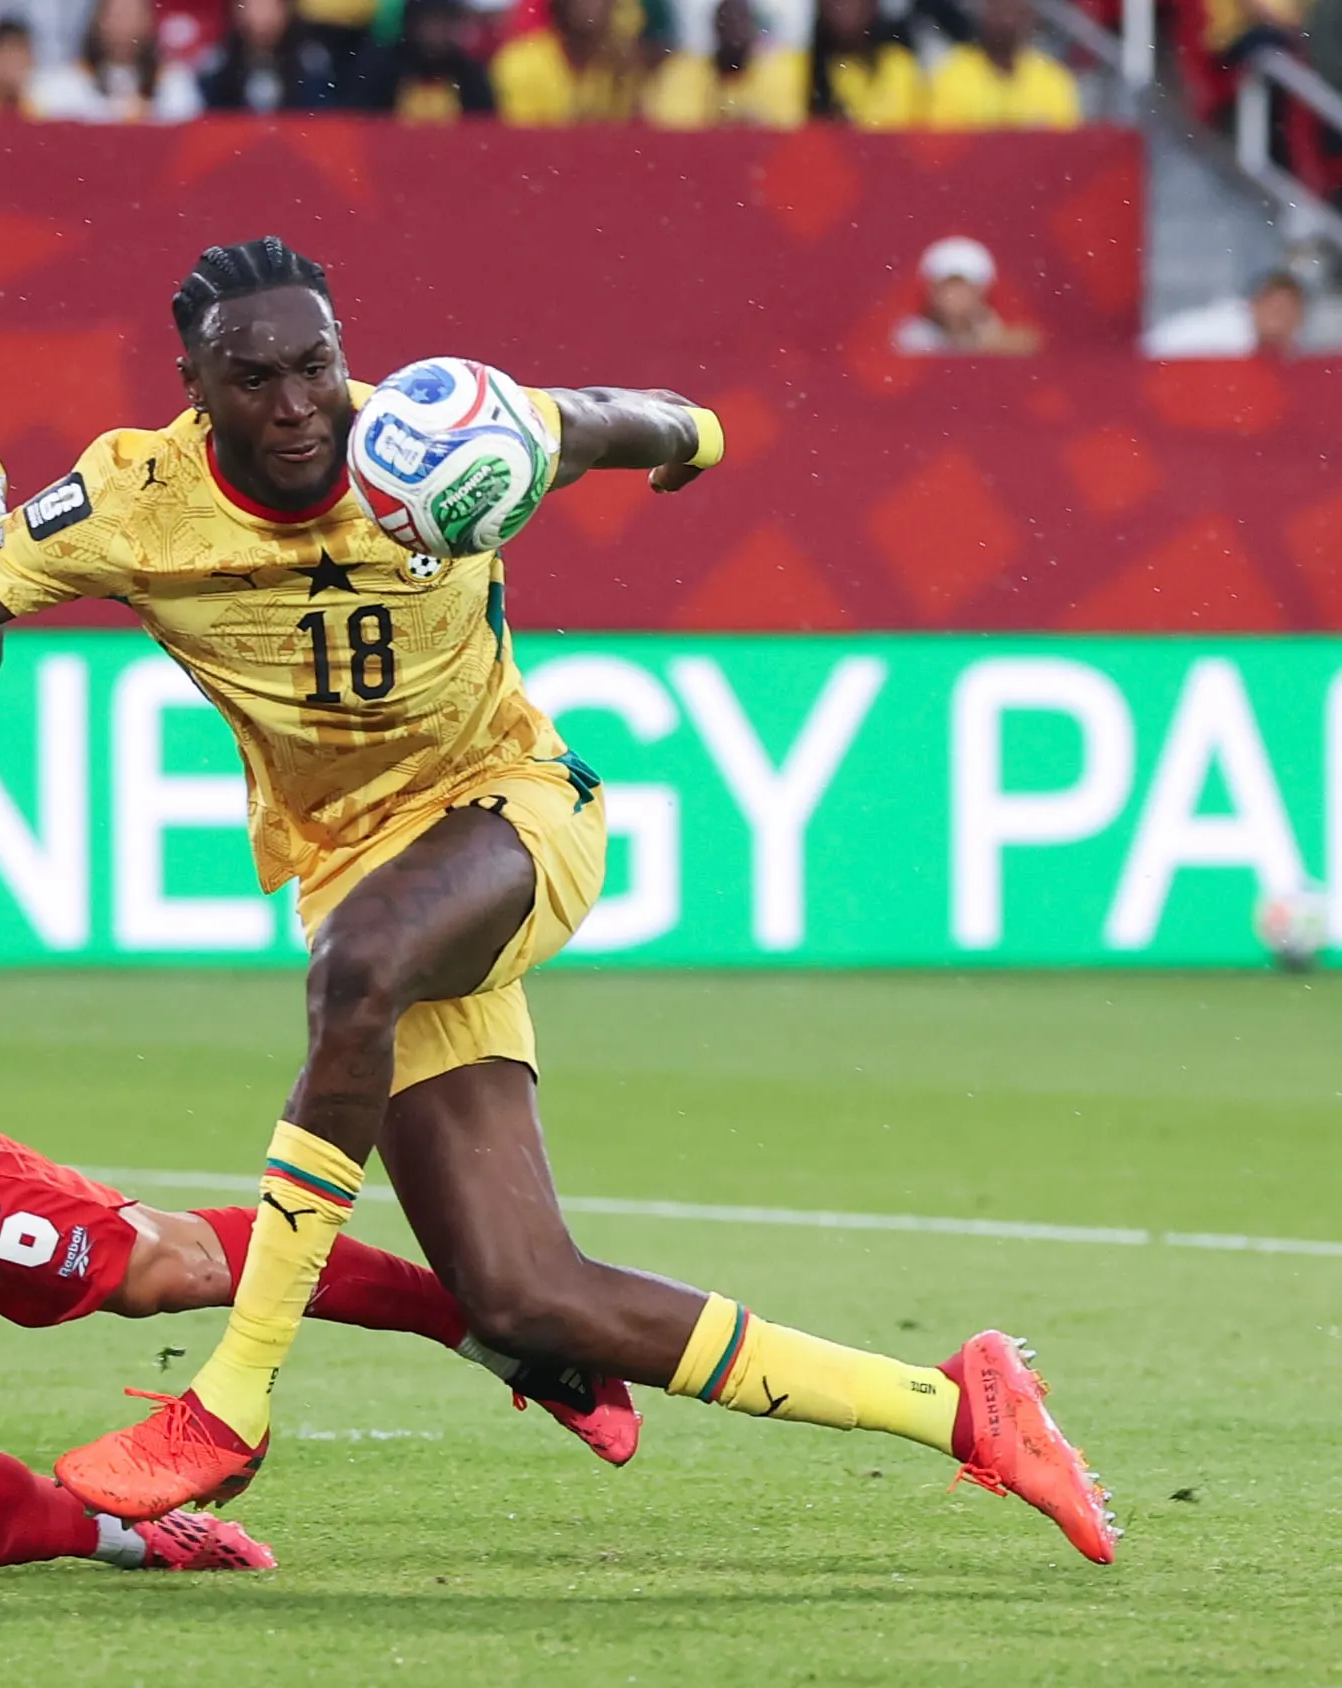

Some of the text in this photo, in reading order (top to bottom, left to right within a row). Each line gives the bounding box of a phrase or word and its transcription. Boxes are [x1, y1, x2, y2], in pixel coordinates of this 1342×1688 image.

[441, 465, 492, 510] TRIONDA
[297, 604, 395, 703] 18
[949, 655, 1342, 951] PA
[58, 1225, 84, 1277] Reebok
